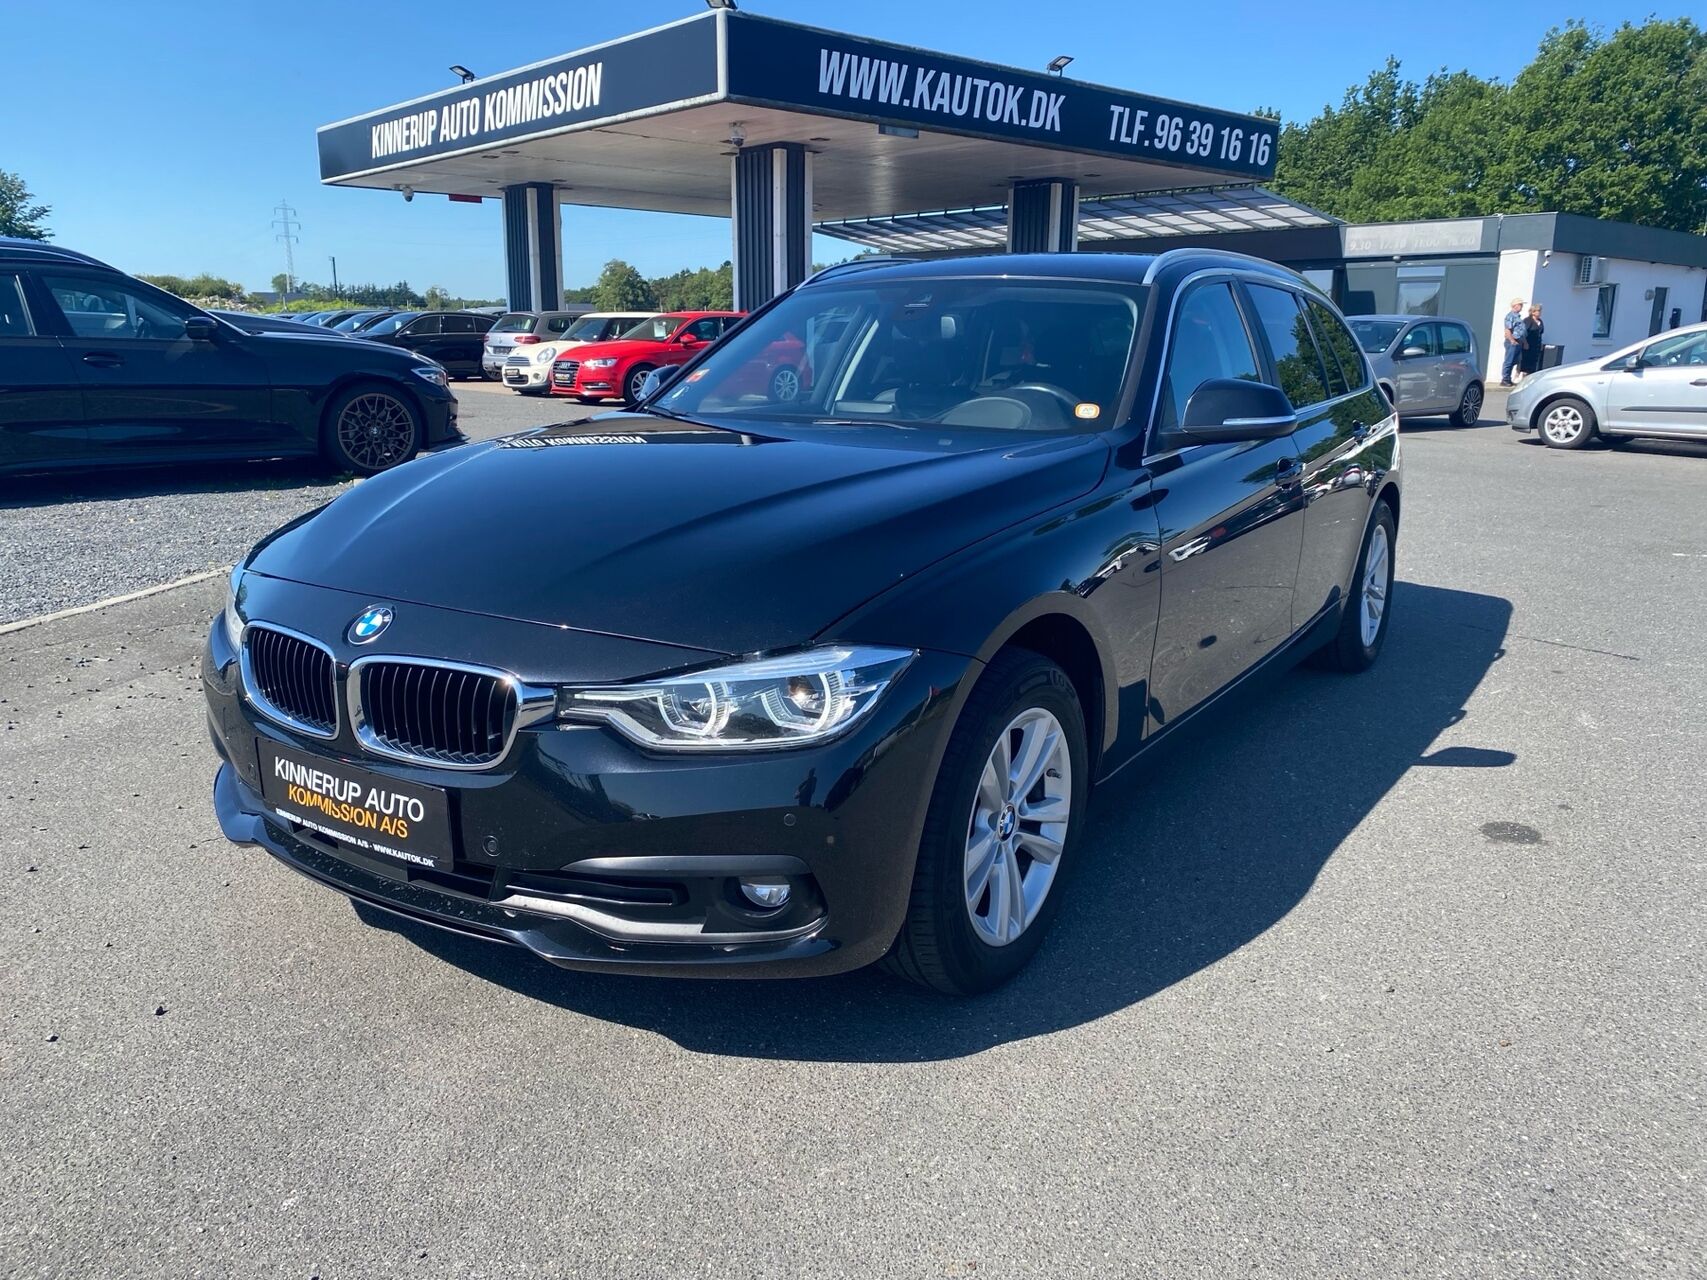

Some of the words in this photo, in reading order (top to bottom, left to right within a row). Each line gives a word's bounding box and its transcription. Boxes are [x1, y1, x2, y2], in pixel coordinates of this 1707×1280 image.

[371, 109, 437, 160] KINNERUP
[439, 97, 480, 143] AUTO
[484, 62, 603, 132] KOMMISSION
[818, 48, 1066, 131] WWW.KAUTOK.DK
[1109, 104, 1150, 147] TLF.
[1153, 114, 1184, 152] 96
[1186, 120, 1214, 157] 39
[1220, 126, 1244, 162] 16
[1249, 132, 1272, 166] 16
[275, 756, 361, 803] KINNERUP
[365, 788, 424, 822] AUTO
[288, 784, 377, 829] KOMMISSION
[380, 818, 408, 838] A/S
